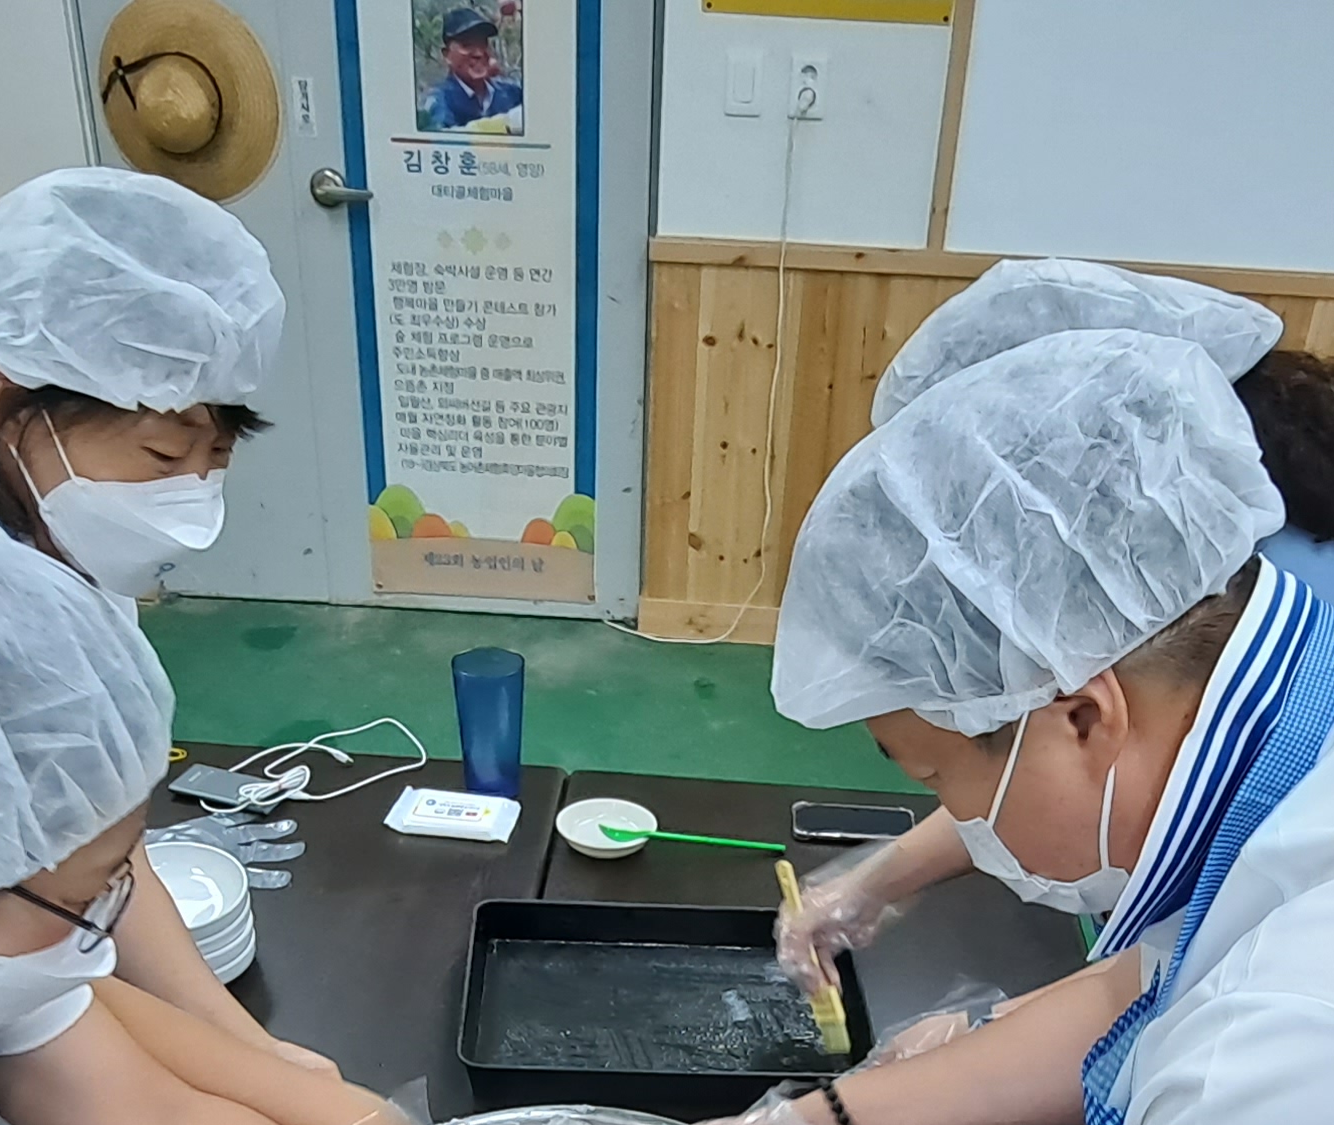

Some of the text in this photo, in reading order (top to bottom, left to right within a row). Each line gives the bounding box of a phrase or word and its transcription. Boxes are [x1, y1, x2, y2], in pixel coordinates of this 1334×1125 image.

[485, 265, 508, 281] 운영
[529, 268, 553, 283] 연간
[443, 298, 478, 313] 만들기
[483, 300, 530, 316] 콘테스트
[438, 332, 483, 348] 프로그램
